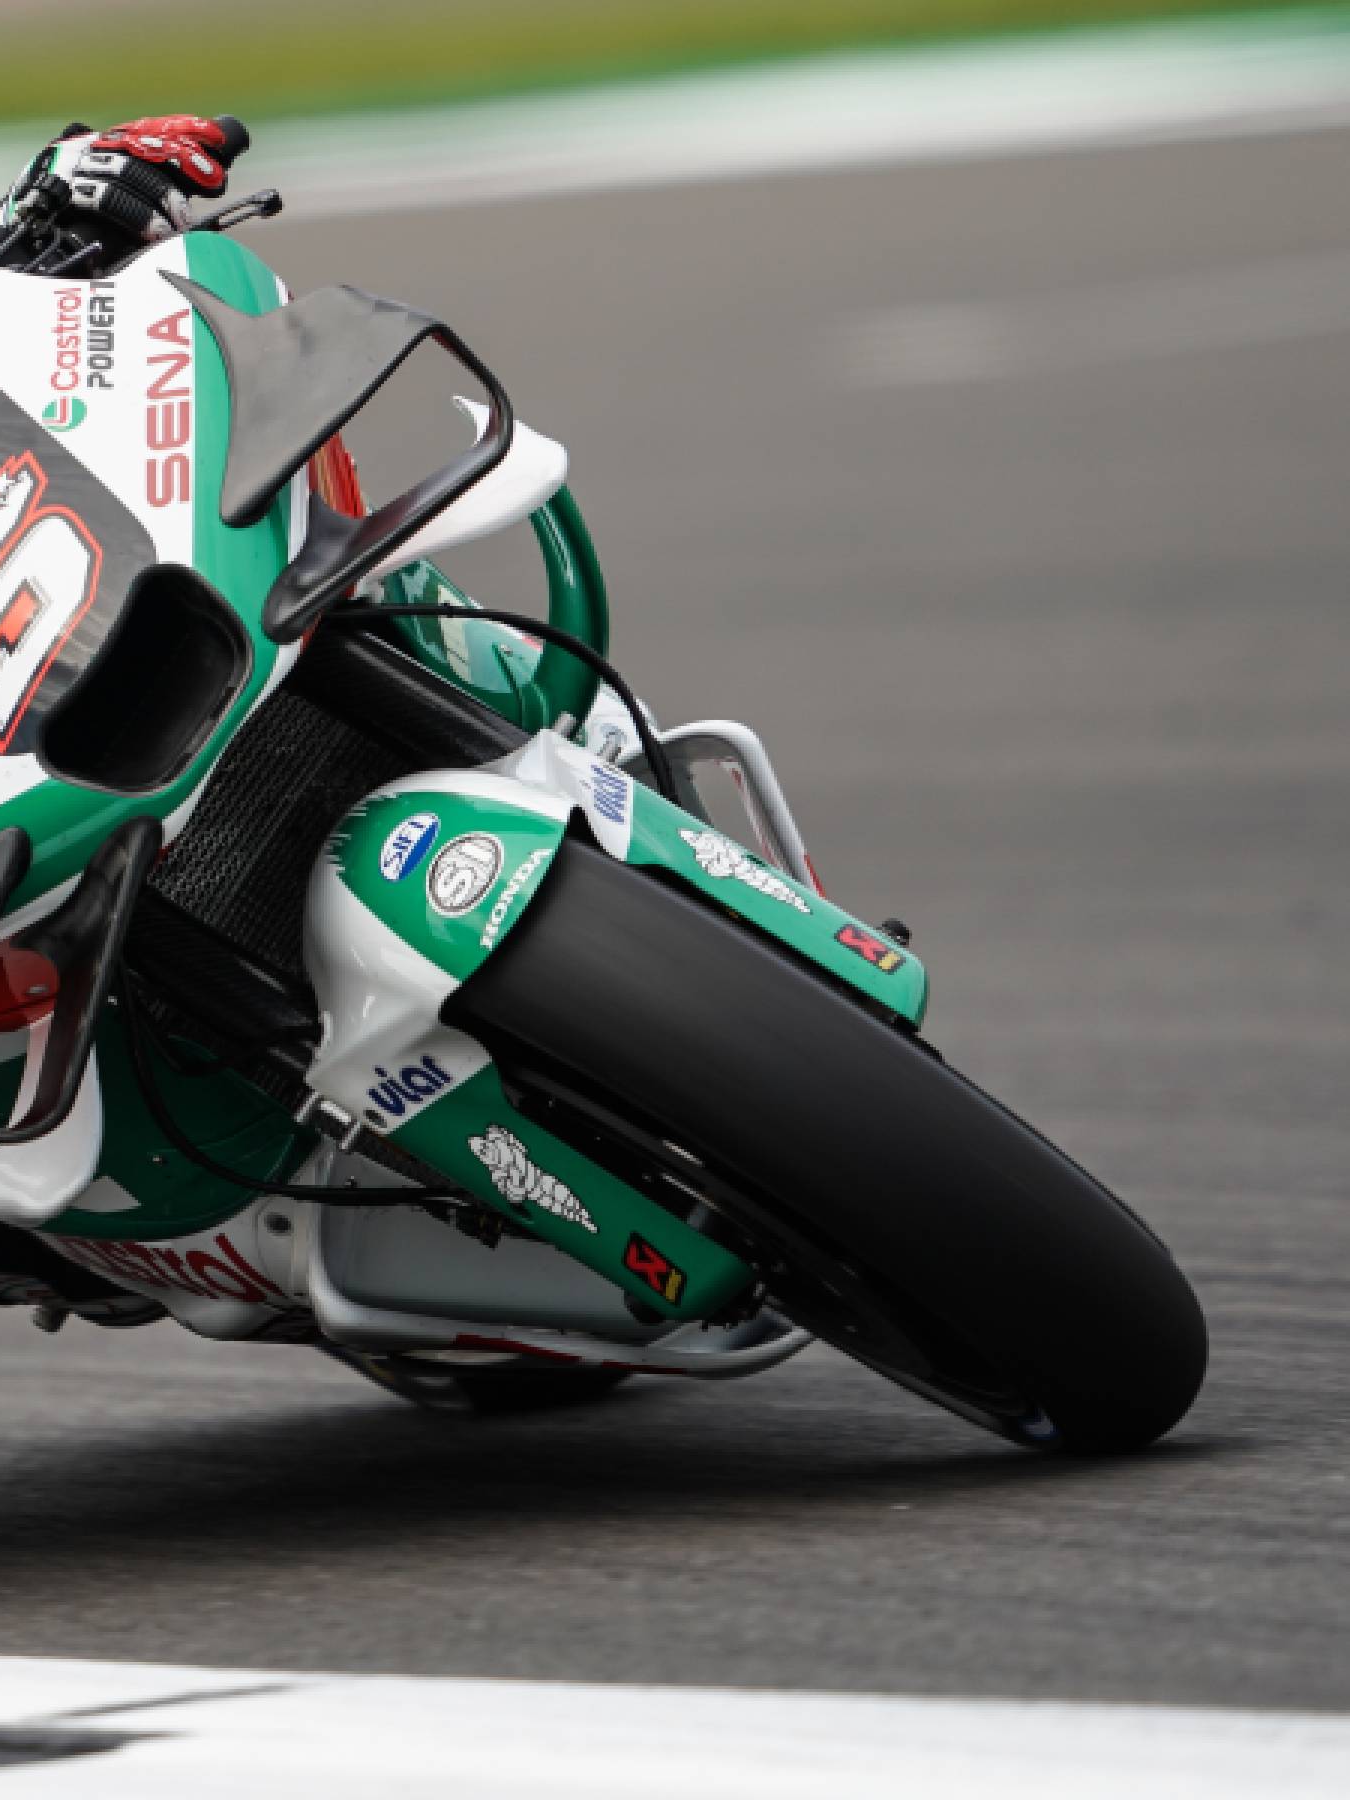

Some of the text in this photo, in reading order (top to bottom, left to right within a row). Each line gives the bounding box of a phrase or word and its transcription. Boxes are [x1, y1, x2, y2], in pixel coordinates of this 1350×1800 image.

[50, 286, 83, 392] Castrol
[86, 280, 116, 389] POWER1
[146, 308, 192, 508] SENA
[478, 846, 553, 948] HONDA
